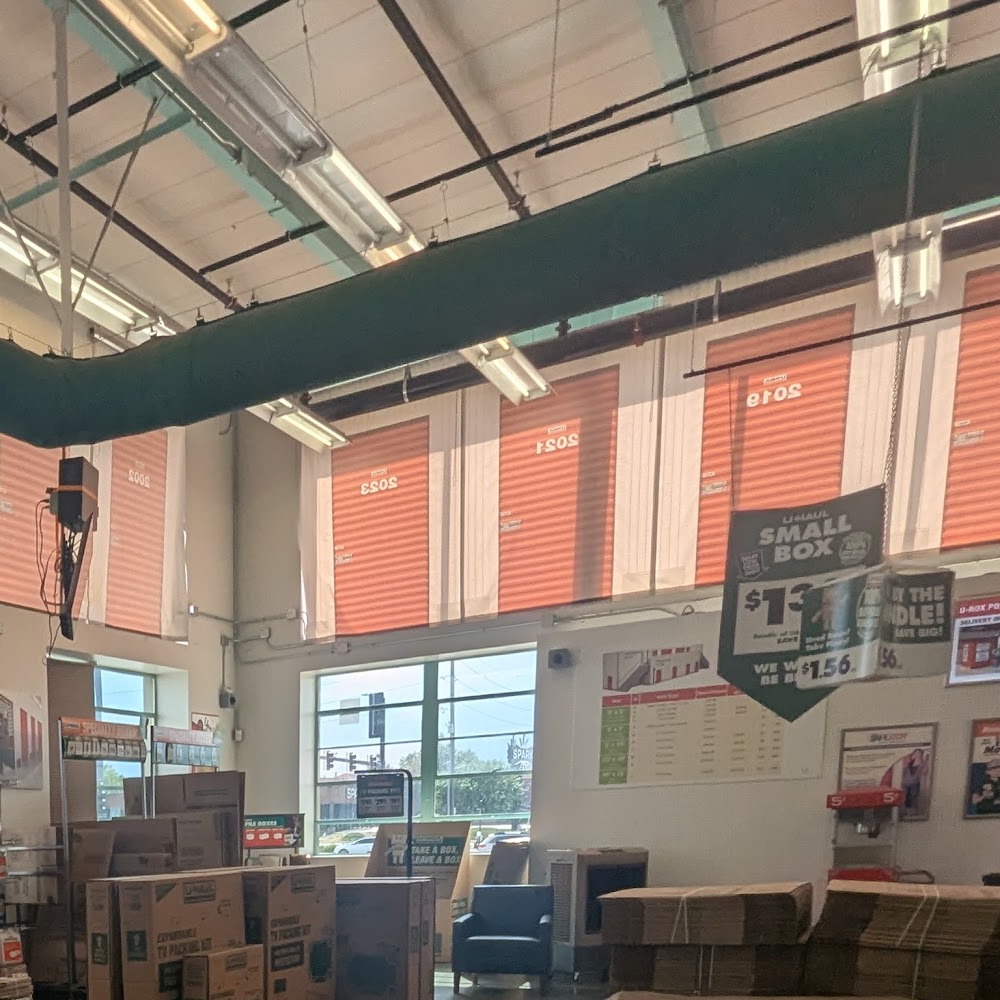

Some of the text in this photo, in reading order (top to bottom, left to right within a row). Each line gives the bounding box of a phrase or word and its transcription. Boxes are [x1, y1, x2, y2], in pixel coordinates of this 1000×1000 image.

[759, 514, 852, 546] SMALL
[773, 537, 834, 563] BOX
[909, 585, 945, 602] THE
[754, 663, 778, 674] WE
[802, 654, 851, 680] $1.56
[880, 648, 897, 669] 56
[760, 674, 779, 686] BE
